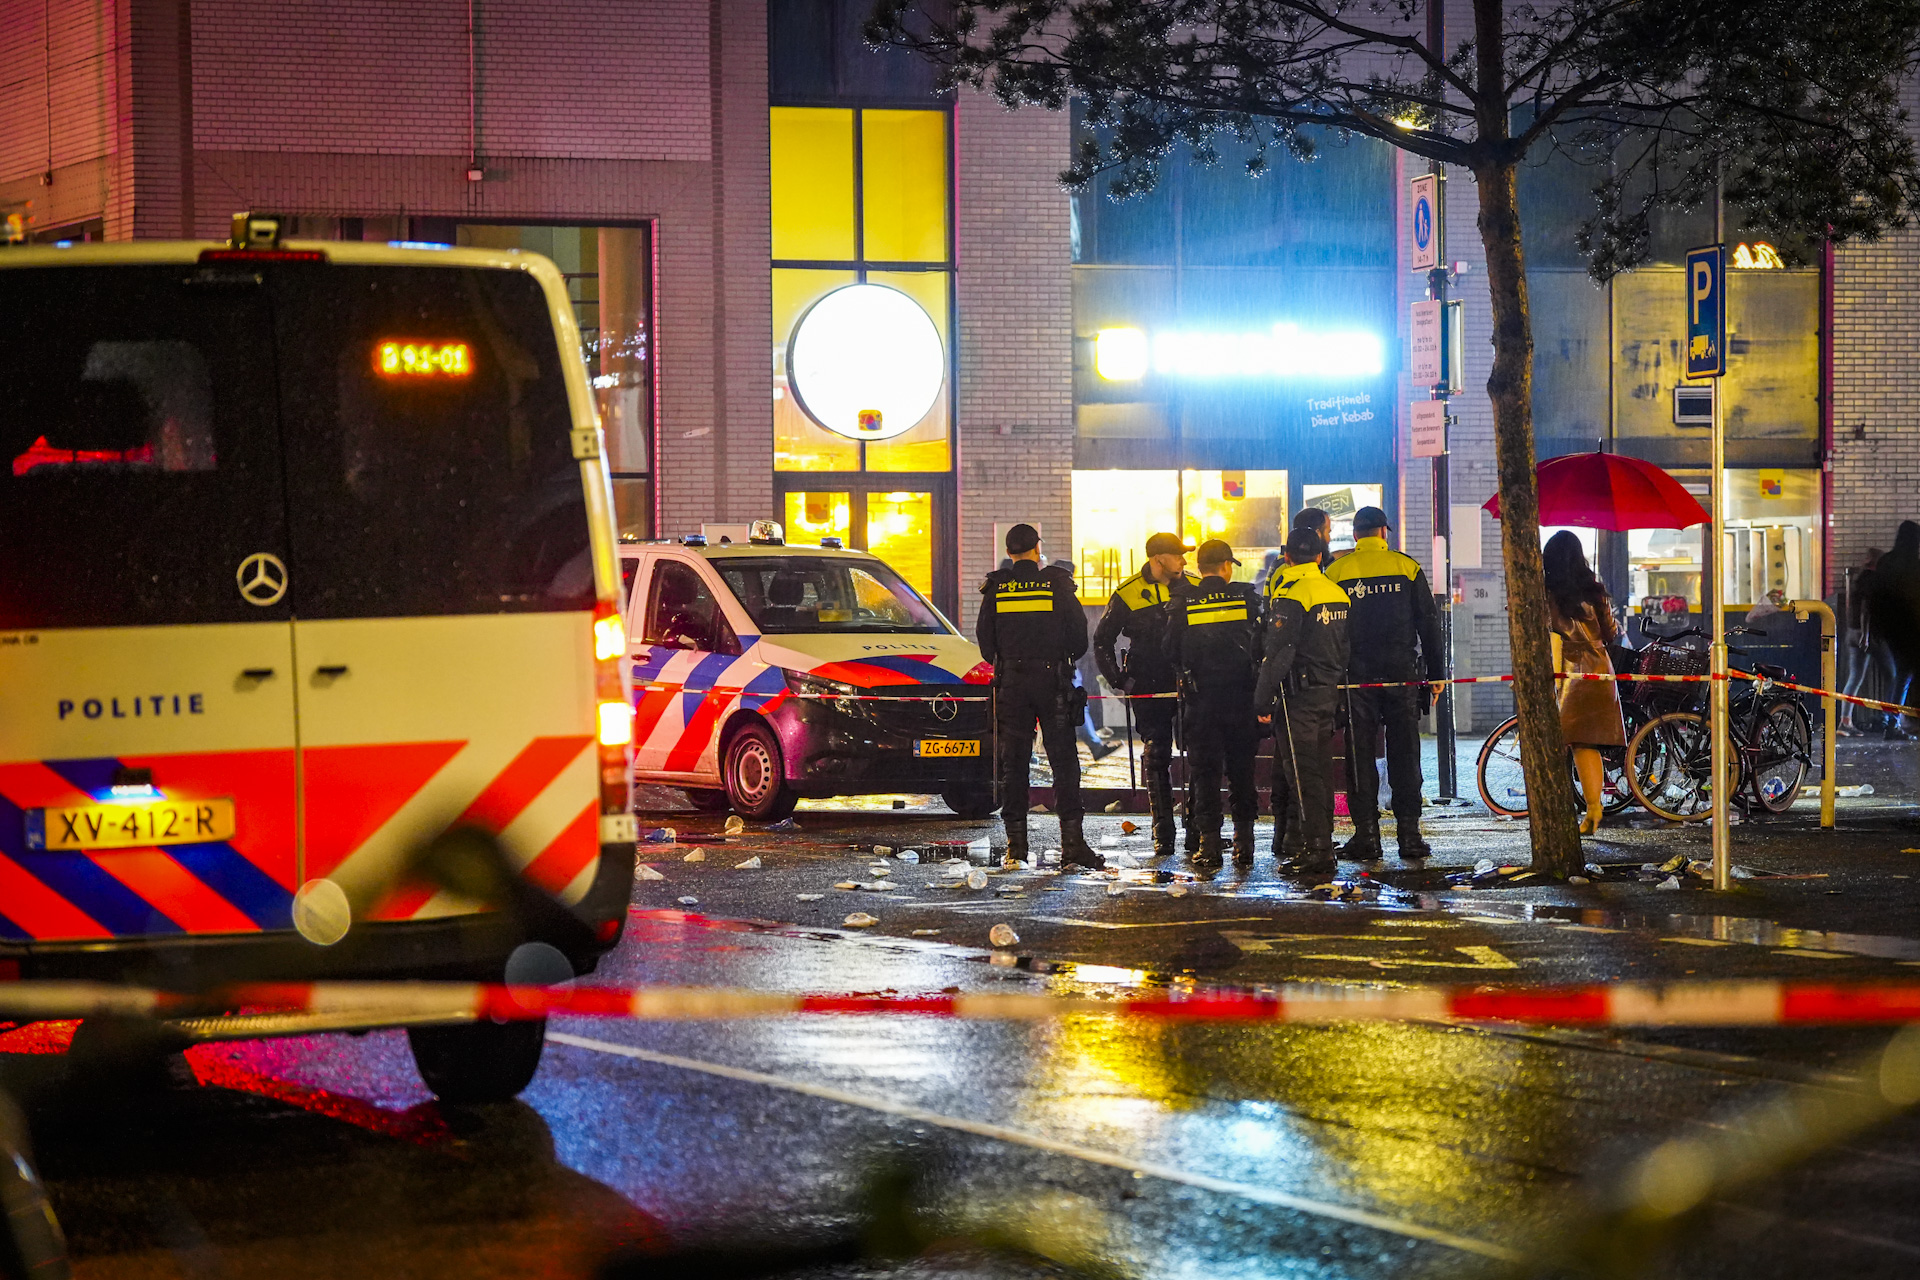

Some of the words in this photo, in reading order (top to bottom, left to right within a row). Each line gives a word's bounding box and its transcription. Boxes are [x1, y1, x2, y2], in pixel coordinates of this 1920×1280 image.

[1693, 261, 1712, 325] P
[1307, 392, 1371, 411] Traditionele
[1311, 414, 1340, 428] Döner
[1342, 408, 1374, 424] Kebab
[1348, 581, 1401, 599] POLITIE
[1317, 607, 1348, 625] POLITIE
[862, 644, 941, 652] POLITIE
[58, 693, 204, 720] POLITIE
[925, 742, 976, 755] ZG-667-X
[61, 806, 214, 843] XV-412-R
